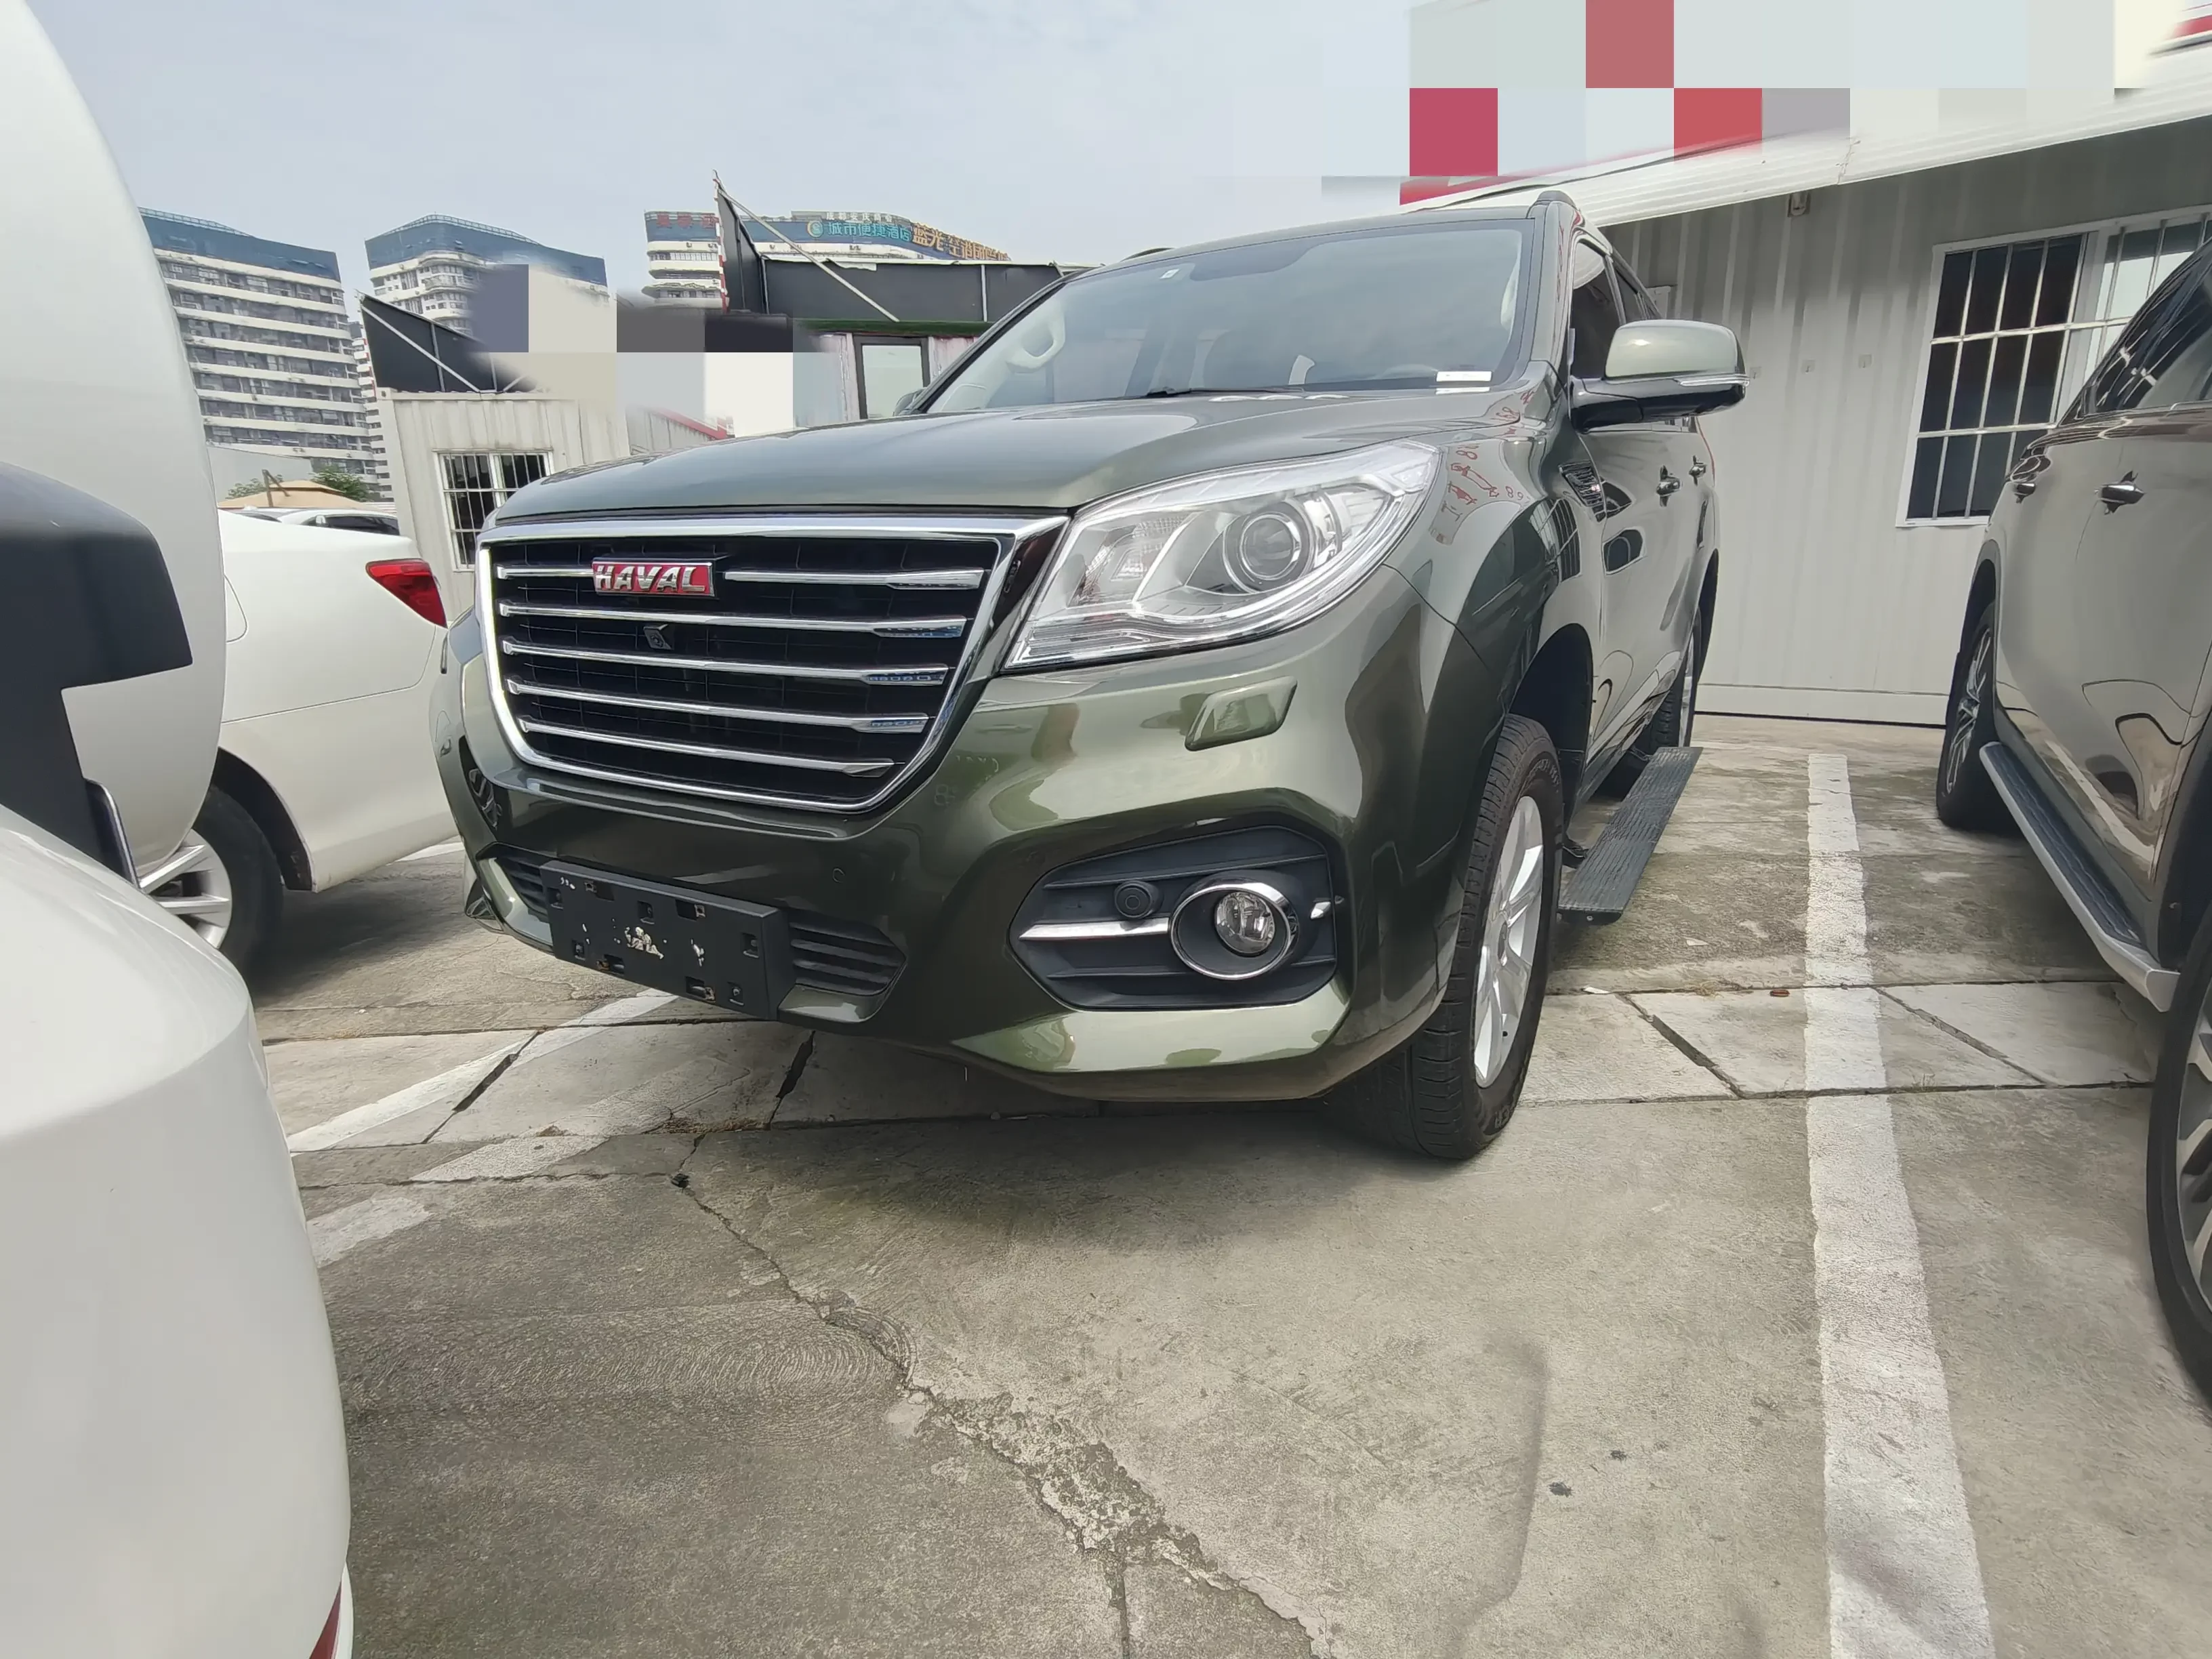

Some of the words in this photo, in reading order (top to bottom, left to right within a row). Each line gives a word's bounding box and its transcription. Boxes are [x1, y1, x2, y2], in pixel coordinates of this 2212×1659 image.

[827, 221, 912, 242] 城市便捷酒店
[595, 565, 705, 592] HAVAL
